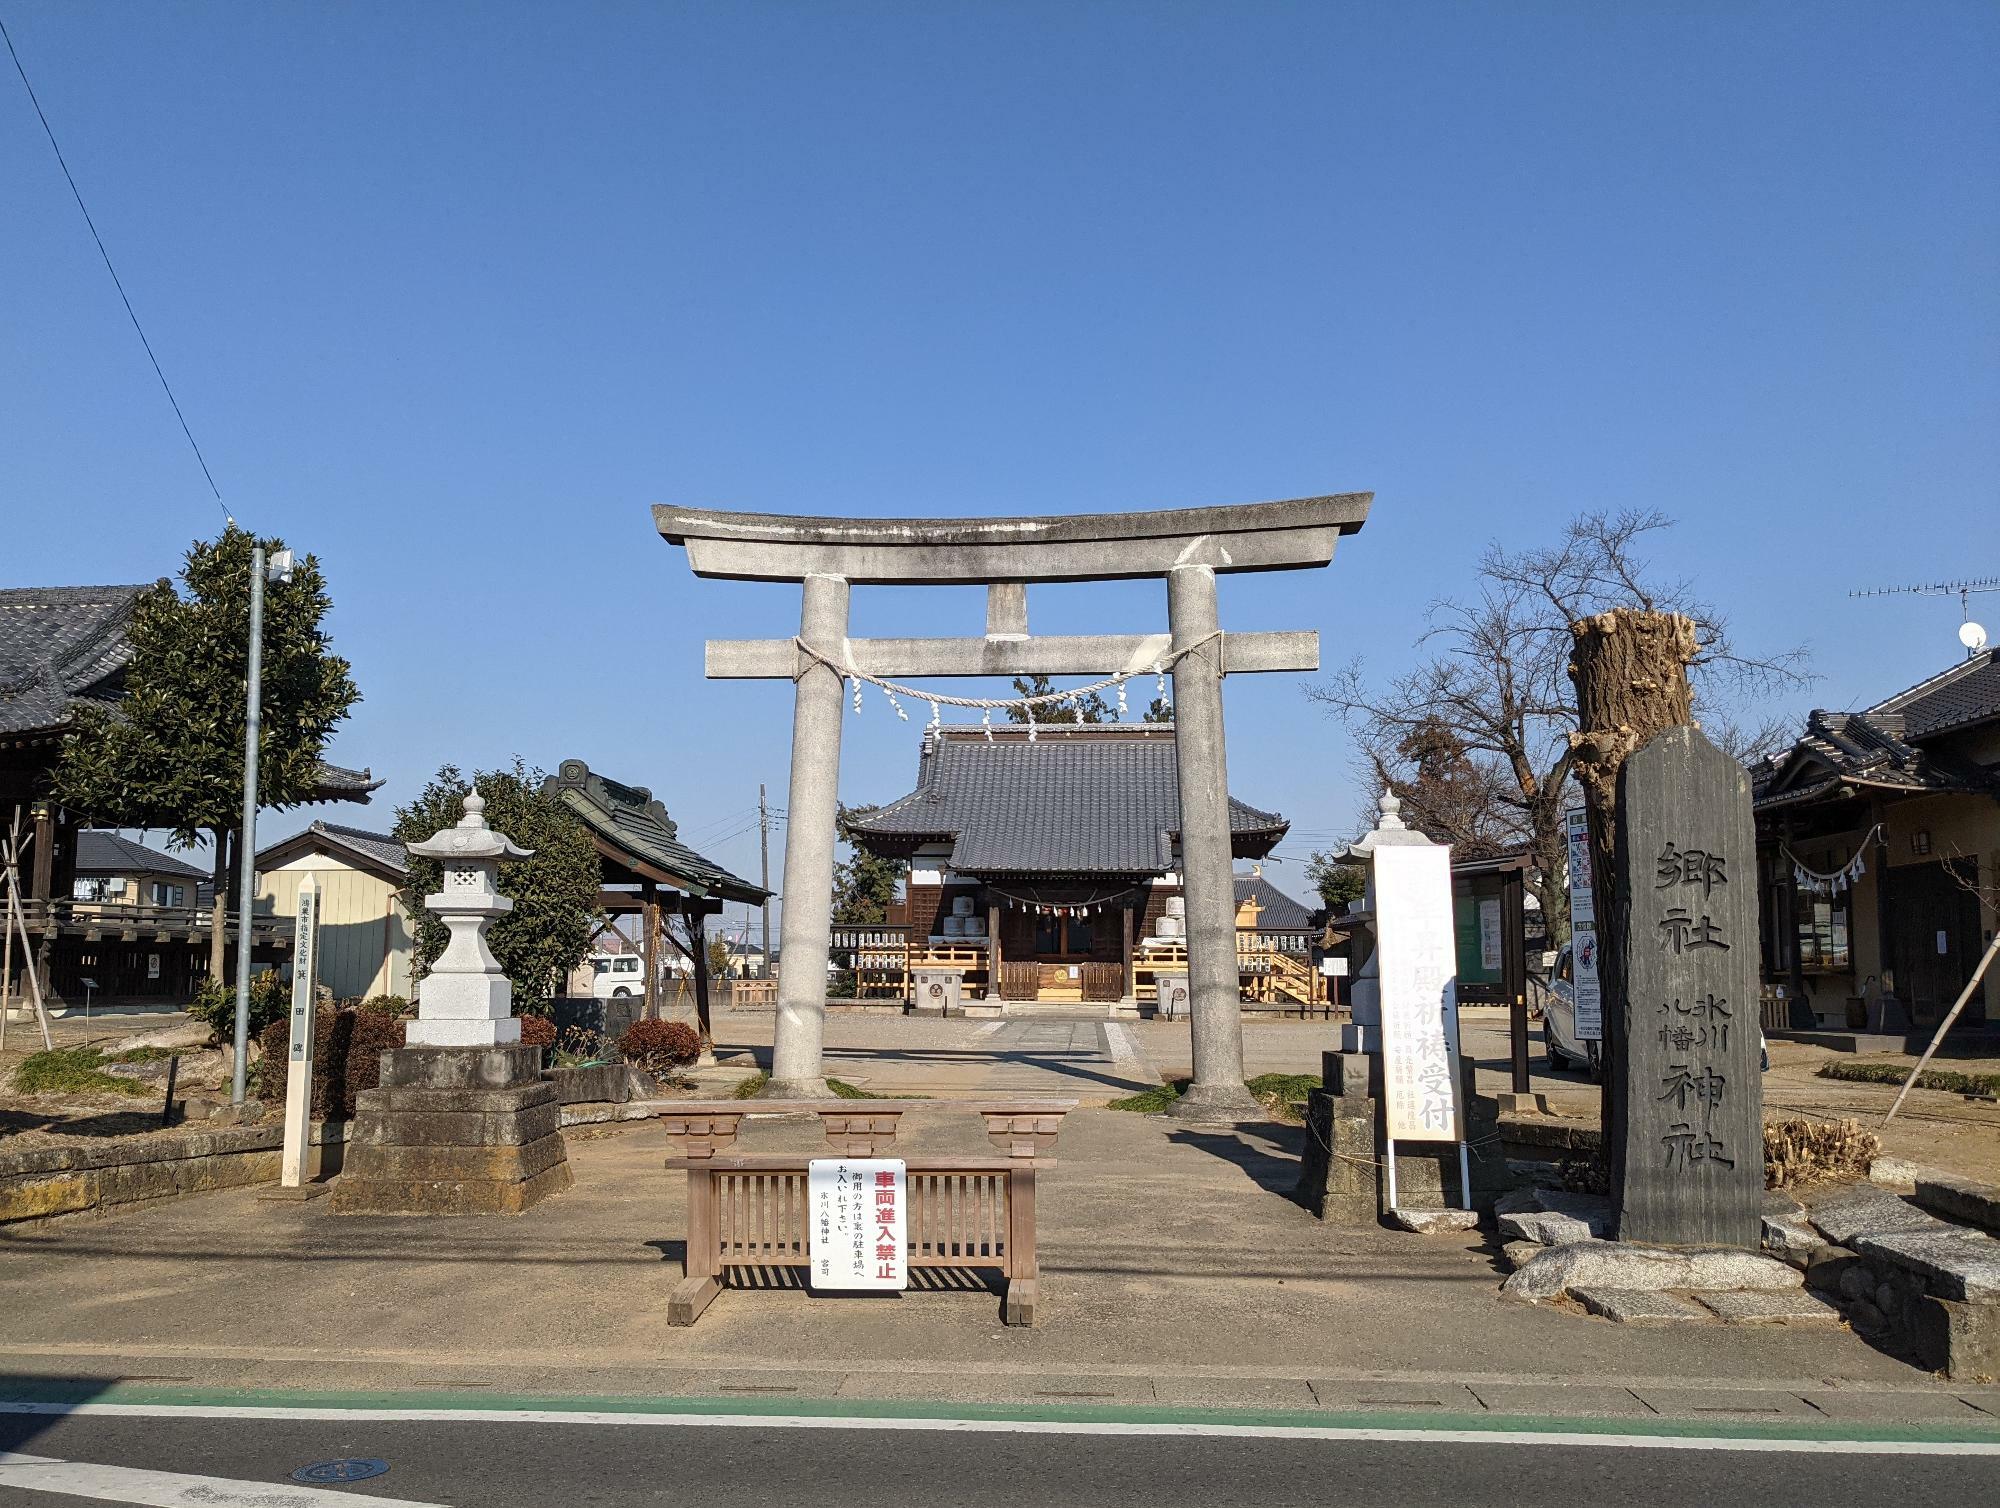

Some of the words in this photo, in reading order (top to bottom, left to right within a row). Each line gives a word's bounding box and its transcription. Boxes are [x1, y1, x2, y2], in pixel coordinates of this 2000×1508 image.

[1655, 842, 1730, 954] 郷社
[299, 899, 310, 965] 鴻巣市指定文化財
[1656, 999, 1696, 1051] 八幡
[1692, 994, 1733, 1052] 氷川
[1657, 1064, 1735, 1173] 神社
[820, 1192, 830, 1244] 氷川八幡神社
[852, 1172, 865, 1278] 御用の方は裏の駐車場へ
[875, 1171, 897, 1280] 車両進入禁止
[821, 1259, 830, 1277] 宮司
